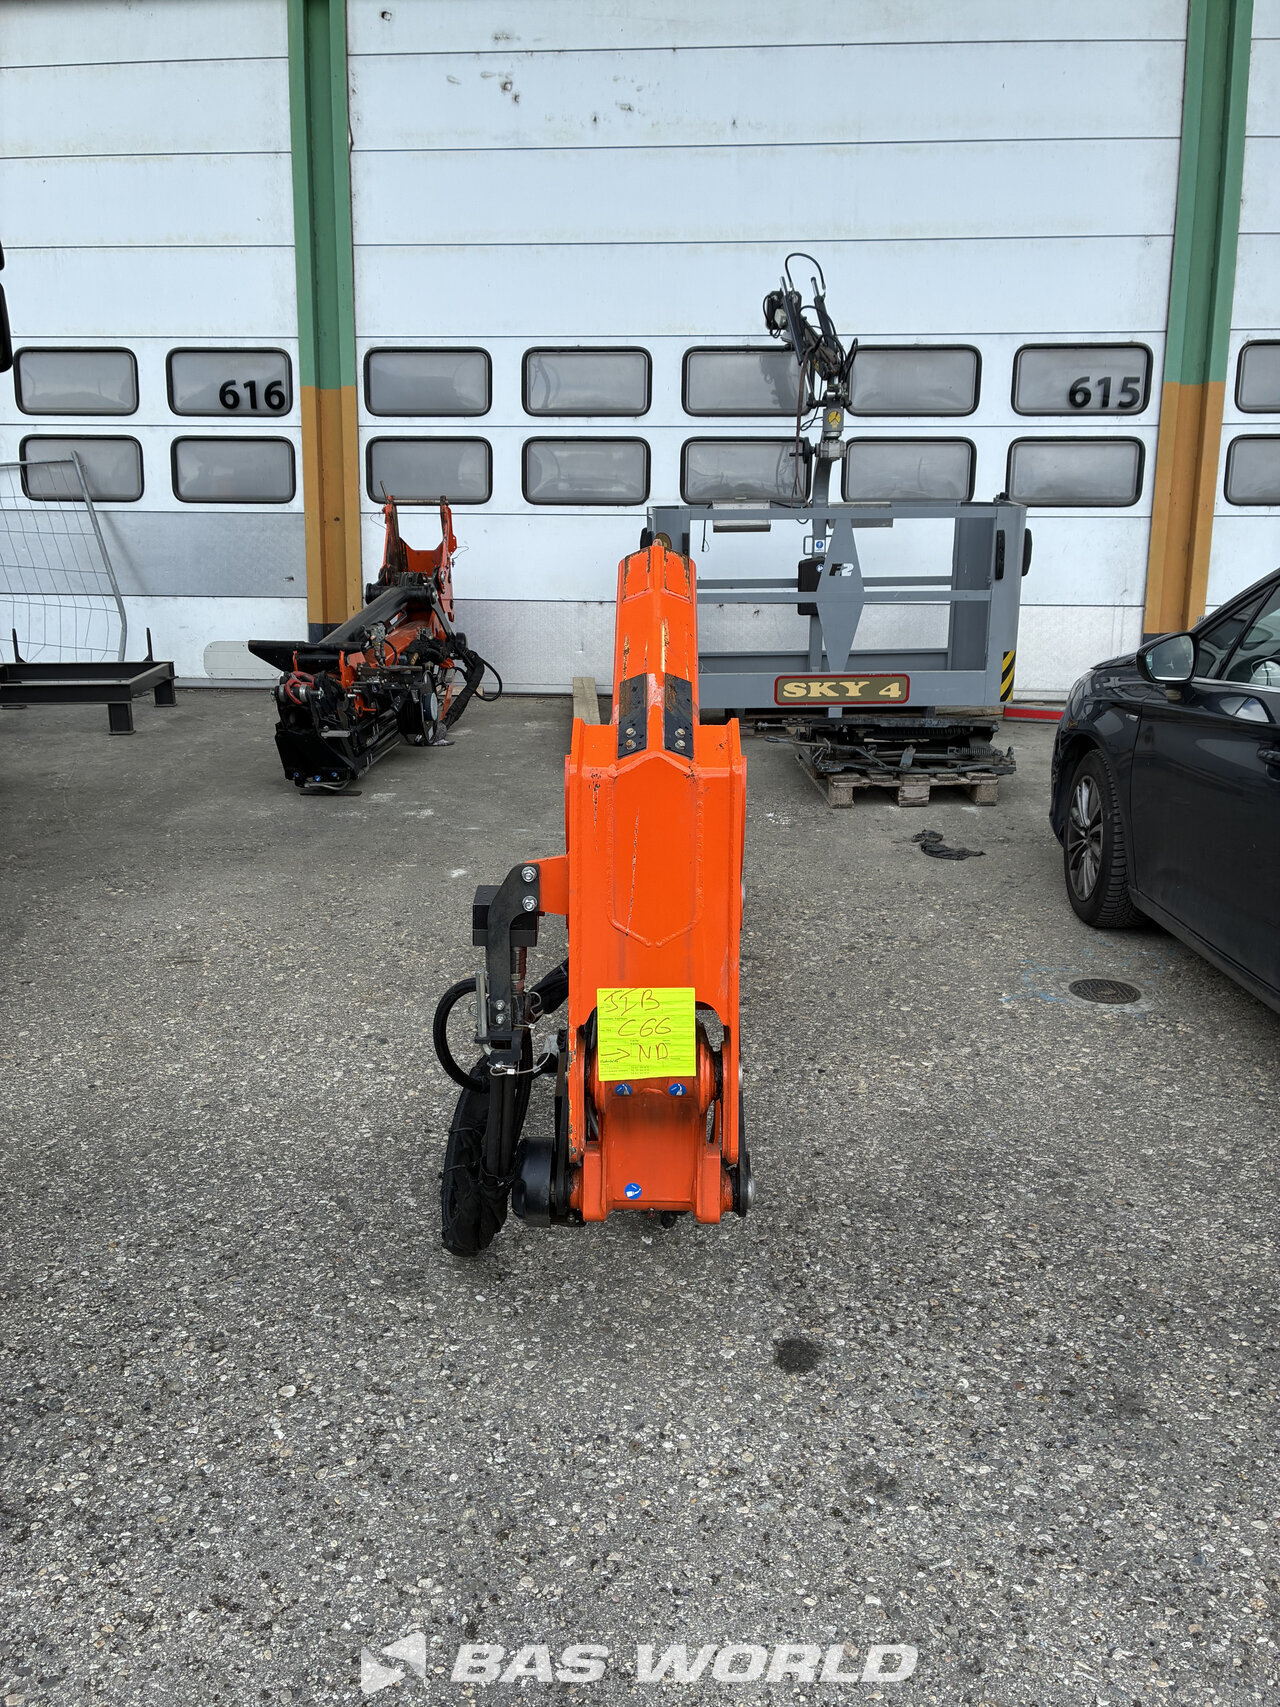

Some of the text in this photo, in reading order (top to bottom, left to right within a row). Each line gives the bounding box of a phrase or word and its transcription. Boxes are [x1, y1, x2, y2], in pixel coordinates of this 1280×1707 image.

[219, 380, 285, 409] 616
[1069, 376, 1140, 408] 615
[829, 563, 854, 576] F2
[783, 681, 901, 697] SKY 4
[639, 1043, 668, 1062] ND
